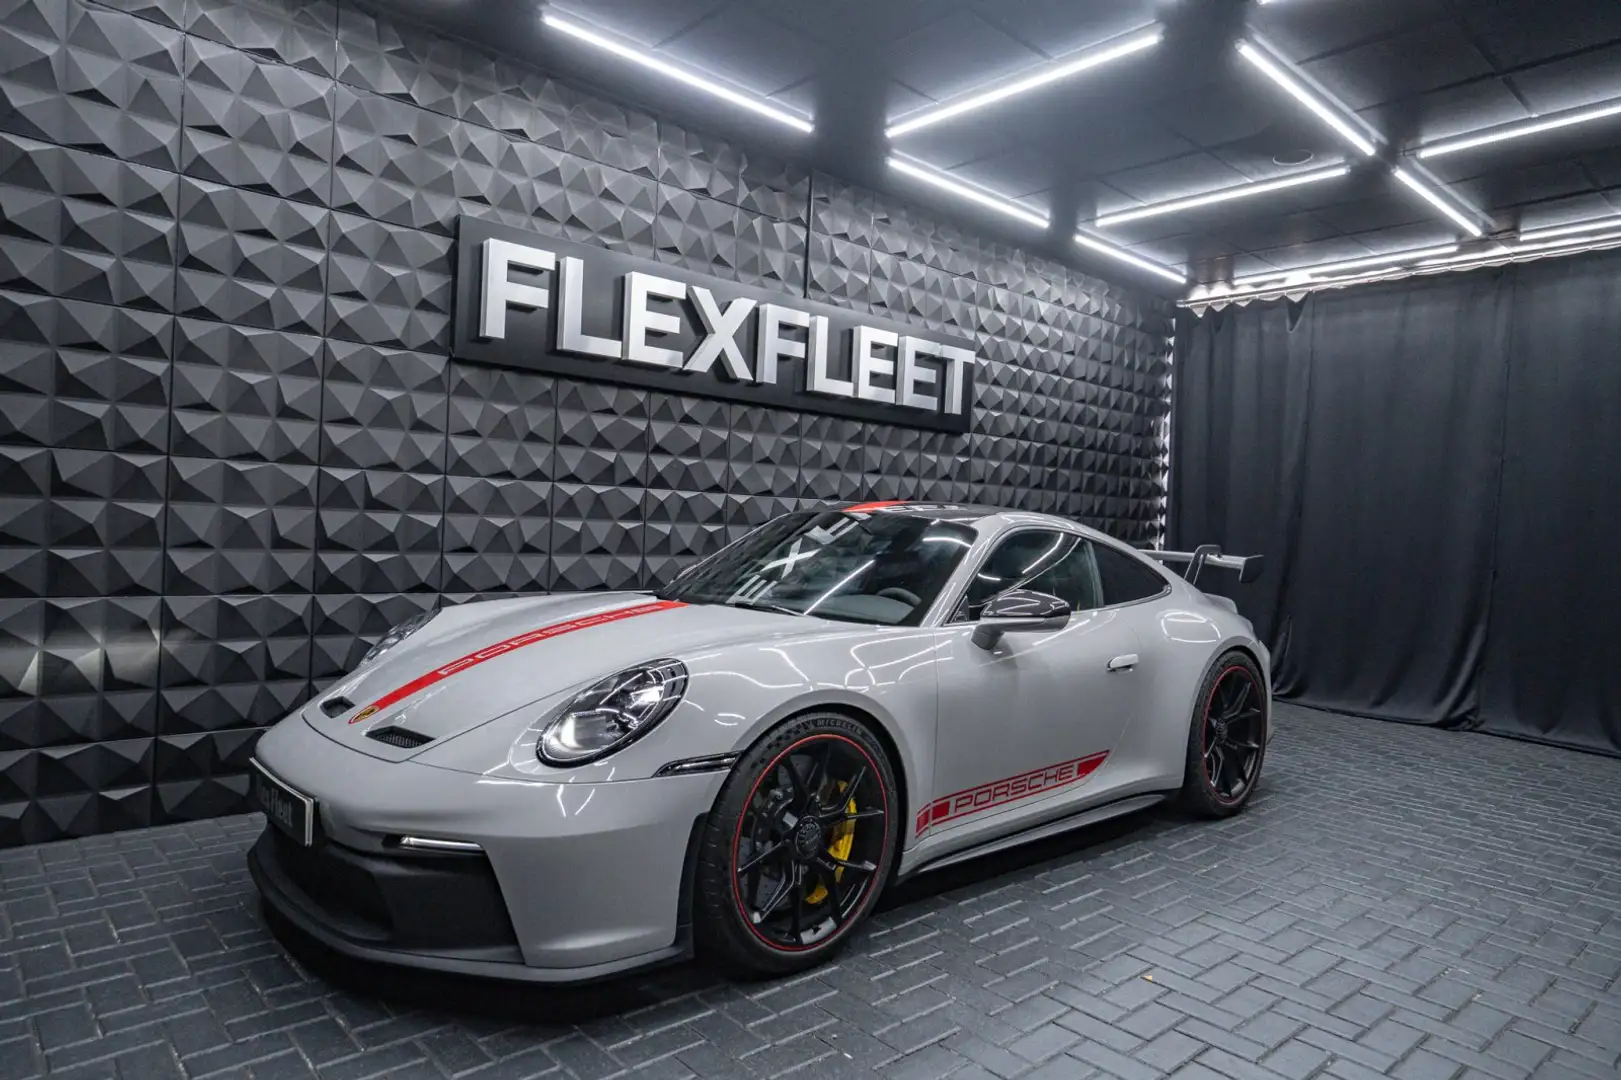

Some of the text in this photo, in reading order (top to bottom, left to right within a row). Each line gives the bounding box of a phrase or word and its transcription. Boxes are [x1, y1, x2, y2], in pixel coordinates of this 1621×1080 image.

[478, 237, 975, 415] FLEXFLEET
[438, 604, 663, 675] PORSCHE
[954, 763, 1075, 813] PORSCHE
